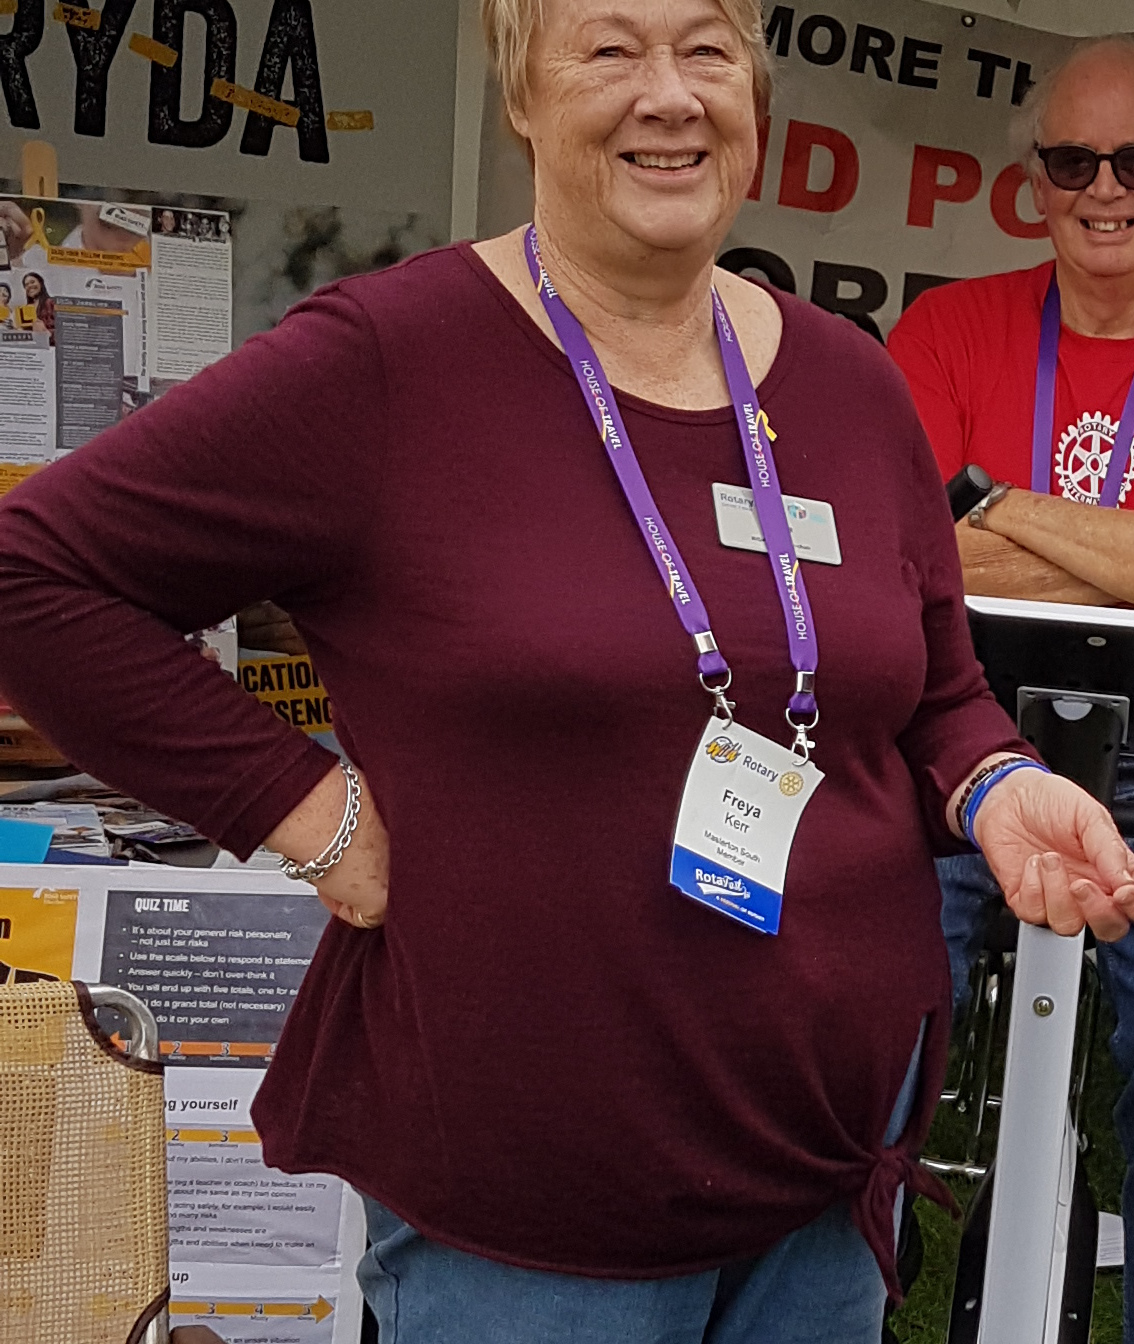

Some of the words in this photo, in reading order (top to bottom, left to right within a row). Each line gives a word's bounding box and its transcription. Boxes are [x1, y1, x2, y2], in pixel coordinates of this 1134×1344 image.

[766, 6, 943, 89] MORE
[907, 144, 1052, 239] PO
[20, 307, 34, 324] L
[580, 359, 602, 394] HOUSE
[595, 397, 609, 417] OF
[602, 414, 623, 451] TRAVEL
[743, 403, 760, 437] TRAVEL
[1079, 422, 1116, 437] ROTARY
[755, 453, 771, 488] HOUSE
[720, 493, 754, 508] Rotary
[644, 517, 667, 552] HOUSE
[661, 552, 676, 571] OF
[669, 569, 691, 605] TRAVEL
[779, 552, 796, 587] TRAVEL
[792, 604, 808, 640] HOUSE
[742, 755, 779, 782] Rotary
[722, 789, 762, 819] Freya
[725, 812, 750, 834] Kerr
[135, 898, 160, 913] QUIZ
[163, 899, 190, 912] TIME
[147, 927, 171, 935] about
[173, 929, 192, 937] your
[194, 930, 227, 938] general
[228, 930, 243, 938] risk
[245, 931, 292, 940] personality
[155, 939, 170, 947] just
[188, 939, 209, 947] risks
[130, 952, 147, 960] Use
[190, 955, 215, 963] below
[228, 957, 262, 965] respond
[128, 968, 161, 976] Answer
[162, 970, 193, 979] quickly
[128, 983, 144, 991] You
[171, 1001, 197, 1010] grand
[220, 1001, 237, 1009] (not
[238, 1002, 286, 1012] necessary)
[156, 1014, 168, 1023] do
[169, 1014, 176, 1023] it
[189, 1017, 209, 1025] your
[172, 1041, 181, 1055] 2
[221, 1042, 230, 1056] 3
[180, 1099, 239, 1112] yourself
[171, 1128, 180, 1142] 2
[220, 1130, 229, 1143] 3
[172, 1272, 189, 1284] up
[207, 1302, 215, 1315] 3
[254, 1303, 263, 1315] 4
